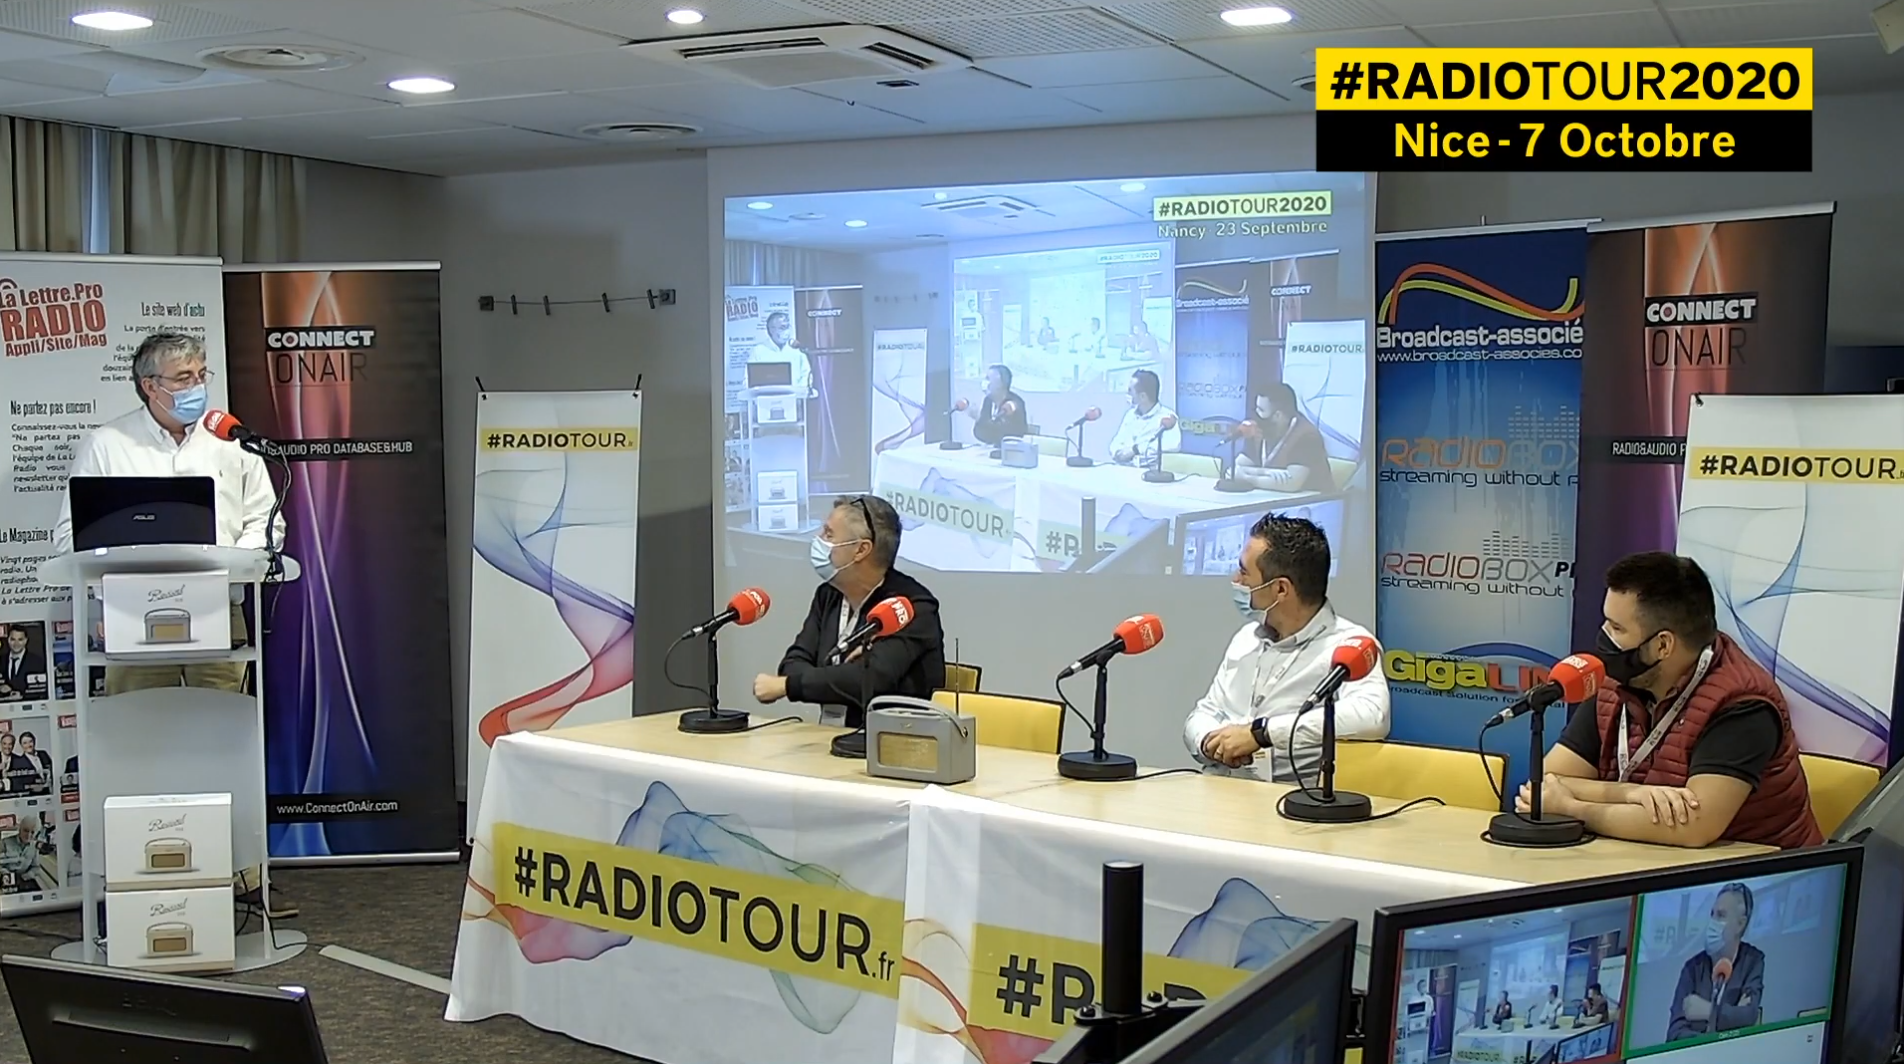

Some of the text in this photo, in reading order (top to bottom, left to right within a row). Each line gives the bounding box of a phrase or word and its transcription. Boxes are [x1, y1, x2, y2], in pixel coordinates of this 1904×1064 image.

[1158, 195, 1328, 218] #RADIOTOUR2020
[1158, 220, 1328, 240] Nancy 23 Septembre
[20, 283, 103, 306] Lettre.Pro
[1646, 299, 1757, 322] CONNECT
[1, 300, 106, 342] RADIO
[268, 330, 375, 349] CONNECT
[1376, 318, 1584, 349] Broadcast-associé
[6, 333, 107, 357] Appli/Site/Mag
[1377, 346, 1583, 362] www.broadcast-associes.co
[10, 400, 21, 415] Ne
[23, 400, 48, 417] partez
[50, 403, 64, 417] pas
[309, 442, 331, 455] PRO
[333, 440, 413, 455] DATABASE&HUB
[1612, 441, 1677, 456] RADIO&AUDIO
[1379, 468, 1477, 488] streaming
[1485, 471, 1561, 486] without
[9, 527, 48, 544] Magazine
[1381, 575, 1565, 597] streaming without
[1389, 686, 1443, 698] roadcast
[277, 800, 398, 814] www.ConnectOnAir.com
[515, 846, 895, 982] #RADIOTOUR.fr
